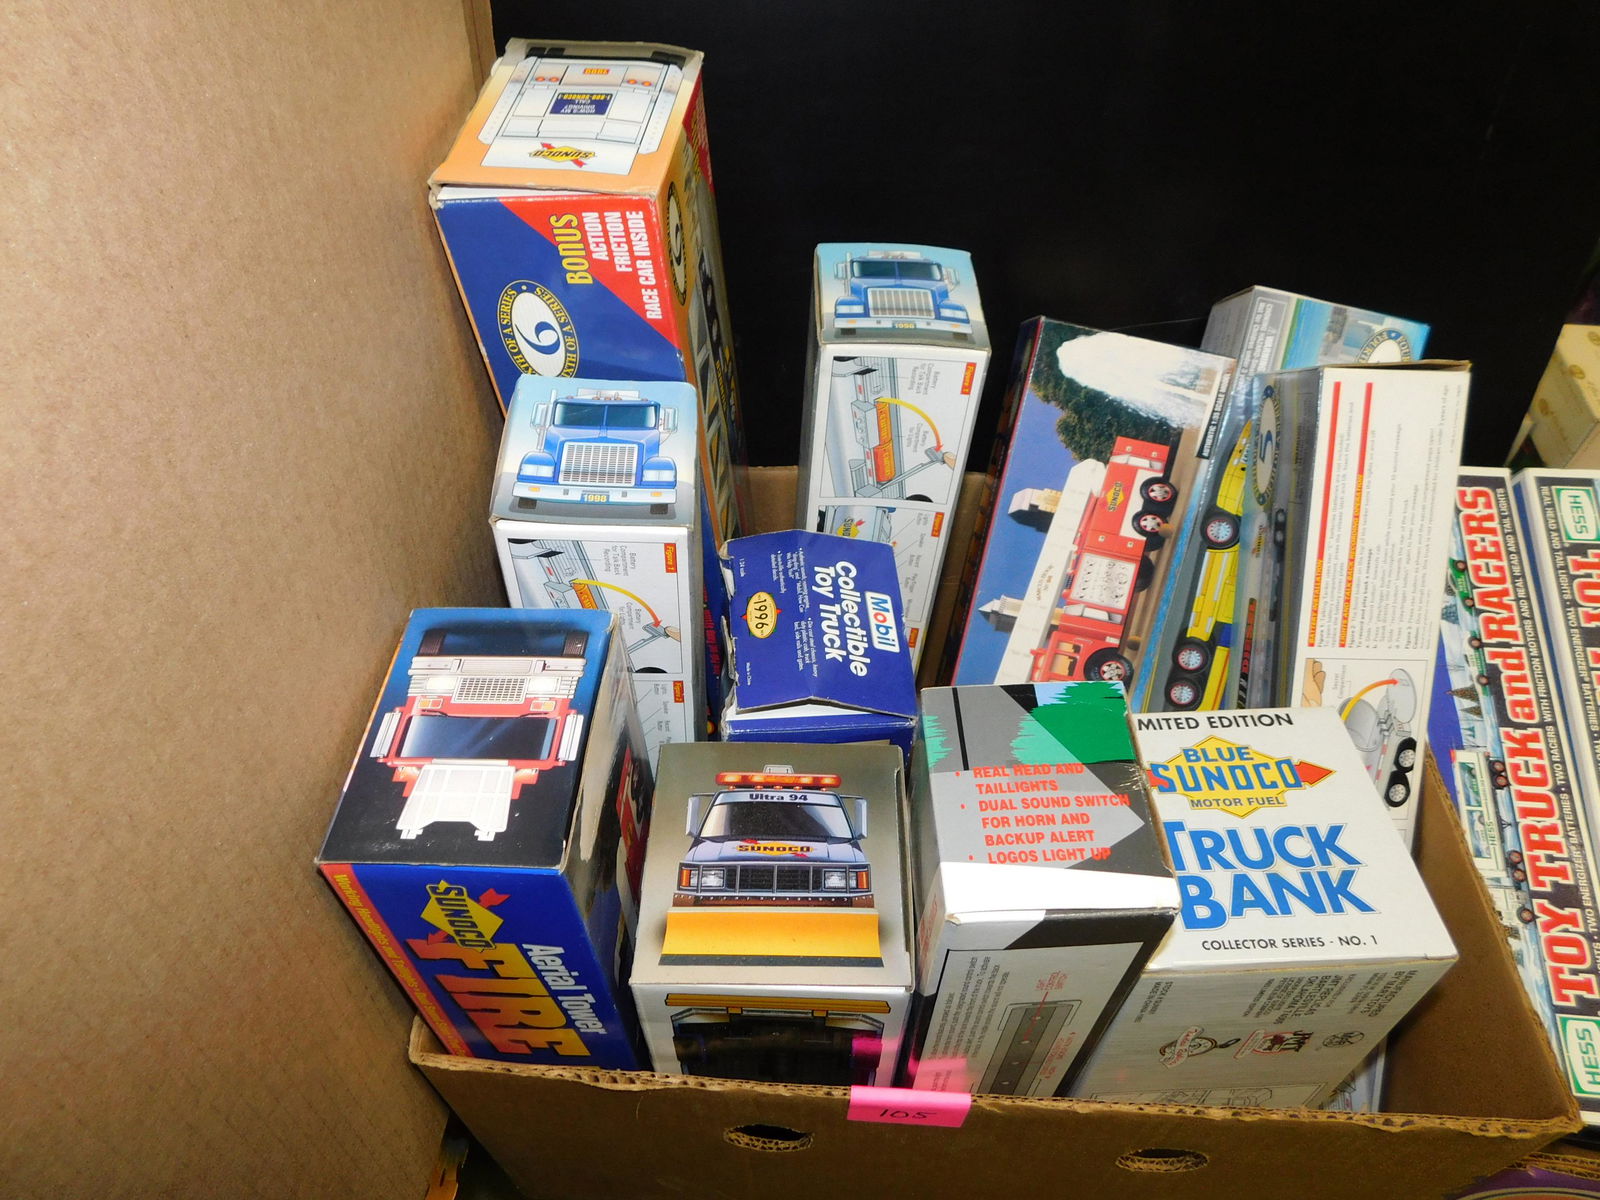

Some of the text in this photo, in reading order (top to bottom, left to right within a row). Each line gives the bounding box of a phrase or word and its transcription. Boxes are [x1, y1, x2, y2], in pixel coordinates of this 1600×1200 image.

[532, 149, 592, 159] SUNOCO
[549, 213, 594, 285] BONUS
[582, 212, 610, 261] ACTION
[604, 211, 633, 272] FRICTION
[626, 210, 662, 319] RACE CAR INSIDE
[500, 288, 536, 375] XTH OF A SERIES
[514, 321, 561, 355] 6
[534, 287, 577, 377] IXTH OF A SERIES
[1398, 334, 1412, 362] FOUR
[964, 364, 974, 386] Figure
[1202, 424, 1217, 457] AUTHENTIC
[1260, 430, 1274, 462] 5
[582, 493, 608, 503] 1998
[1108, 482, 1122, 512] SUNOCO
[1495, 487, 1509, 515] LIGHTS
[842, 518, 854, 536] SUNO
[1501, 516, 1512, 533] TAIL
[1567, 494, 1588, 534] HESS
[666, 545, 674, 566] Figure
[1339, 473, 1364, 643] LIGHTS AND TALK BACK RECORDING OPERATION
[1505, 535, 1516, 552] AND
[603, 548, 612, 572] Recording
[620, 546, 630, 576] Compartment
[628, 552, 637, 569] Battery
[1509, 553, 1521, 574] HEAD
[1308, 559, 1323, 643] BATTERY INSTALLATION
[1514, 577, 1526, 597] REAL
[753, 598, 768, 630] 1996
[812, 566, 847, 662] Toy Truck
[835, 560, 872, 677] Collectible
[869, 596, 897, 649] Mobil
[1519, 599, 1530, 617] AND
[1540, 485, 1597, 730] REAL HEAD AND TAIL LIGHTS TWO BATTERIES
[1243, 600, 1257, 672] DIESEL
[1523, 619, 1538, 656] MOTORS
[674, 682, 682, 696] Figure
[1531, 657, 1546, 697] FRICTION
[1137, 713, 1294, 732] MITED EDITION
[1539, 698, 1551, 722] WITH
[1182, 746, 1254, 763] BLUE
[1456, 486, 1599, 1008] TOY TRUCK and RACERS
[1545, 725, 1560, 761] RACERS
[973, 763, 1084, 778] REAL HEAD AND
[1150, 758, 1303, 793] SUNOCO
[1553, 762, 1564, 784] TWO
[749, 792, 808, 802] Ultra 94
[976, 780, 1059, 794] TAILLIGHTS
[978, 794, 1130, 812] DUAL SOUND SWITCH
[1190, 796, 1285, 809] MOTOR FUEL
[982, 812, 1090, 828] FOR HORN AND
[1488, 820, 1497, 846] HESS
[1559, 793, 1577, 843] BATTERIES
[738, 844, 812, 852] SUNOCO
[984, 830, 1095, 846] BACKUP ALERT
[1162, 820, 1365, 872] TRUCK
[988, 847, 1112, 864] LOGOS LIGHT UP
[1177, 869, 1378, 931] BANK
[333, 874, 362, 908] Working
[356, 906, 389, 948] Headlights
[383, 946, 399, 959] and
[428, 884, 495, 950] SUNOCO
[1583, 907, 1595, 933] TWO
[1202, 937, 1278, 952] COLLECTOR
[1282, 936, 1325, 948] SERIES
[1338, 934, 1367, 947] NO.
[406, 938, 591, 1056] FIRE
[522, 944, 607, 1034] Aerial Tower
[1576, 1027, 1600, 1086] HESS
[880, 1108, 937, 1120] 105
